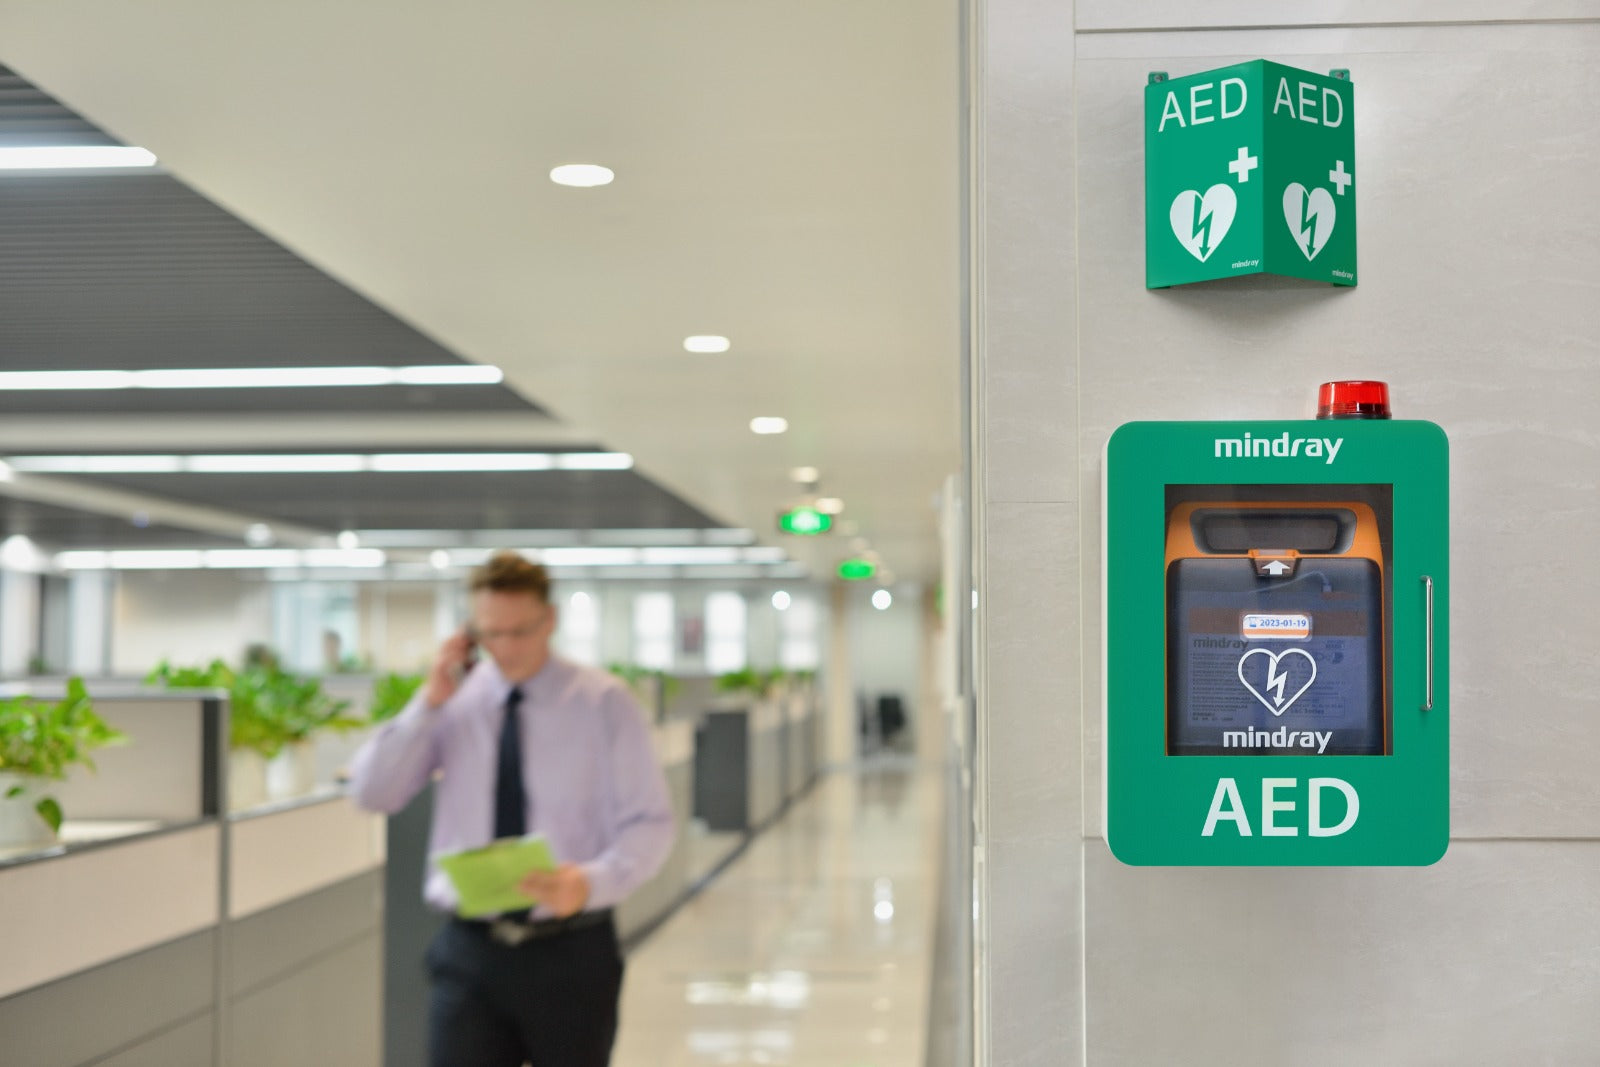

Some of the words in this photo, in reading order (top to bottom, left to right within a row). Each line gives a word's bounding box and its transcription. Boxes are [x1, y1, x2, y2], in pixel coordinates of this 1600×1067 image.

[1158, 77, 1248, 132] AED
[1273, 76, 1343, 128] AED
[1231, 258, 1259, 269] mindray
[1331, 268, 1354, 280] mindray
[1214, 432, 1344, 464] mindray
[1260, 618, 1307, 628] 2023-01-19
[1223, 726, 1333, 754] mindray
[1201, 777, 1360, 837] AED
